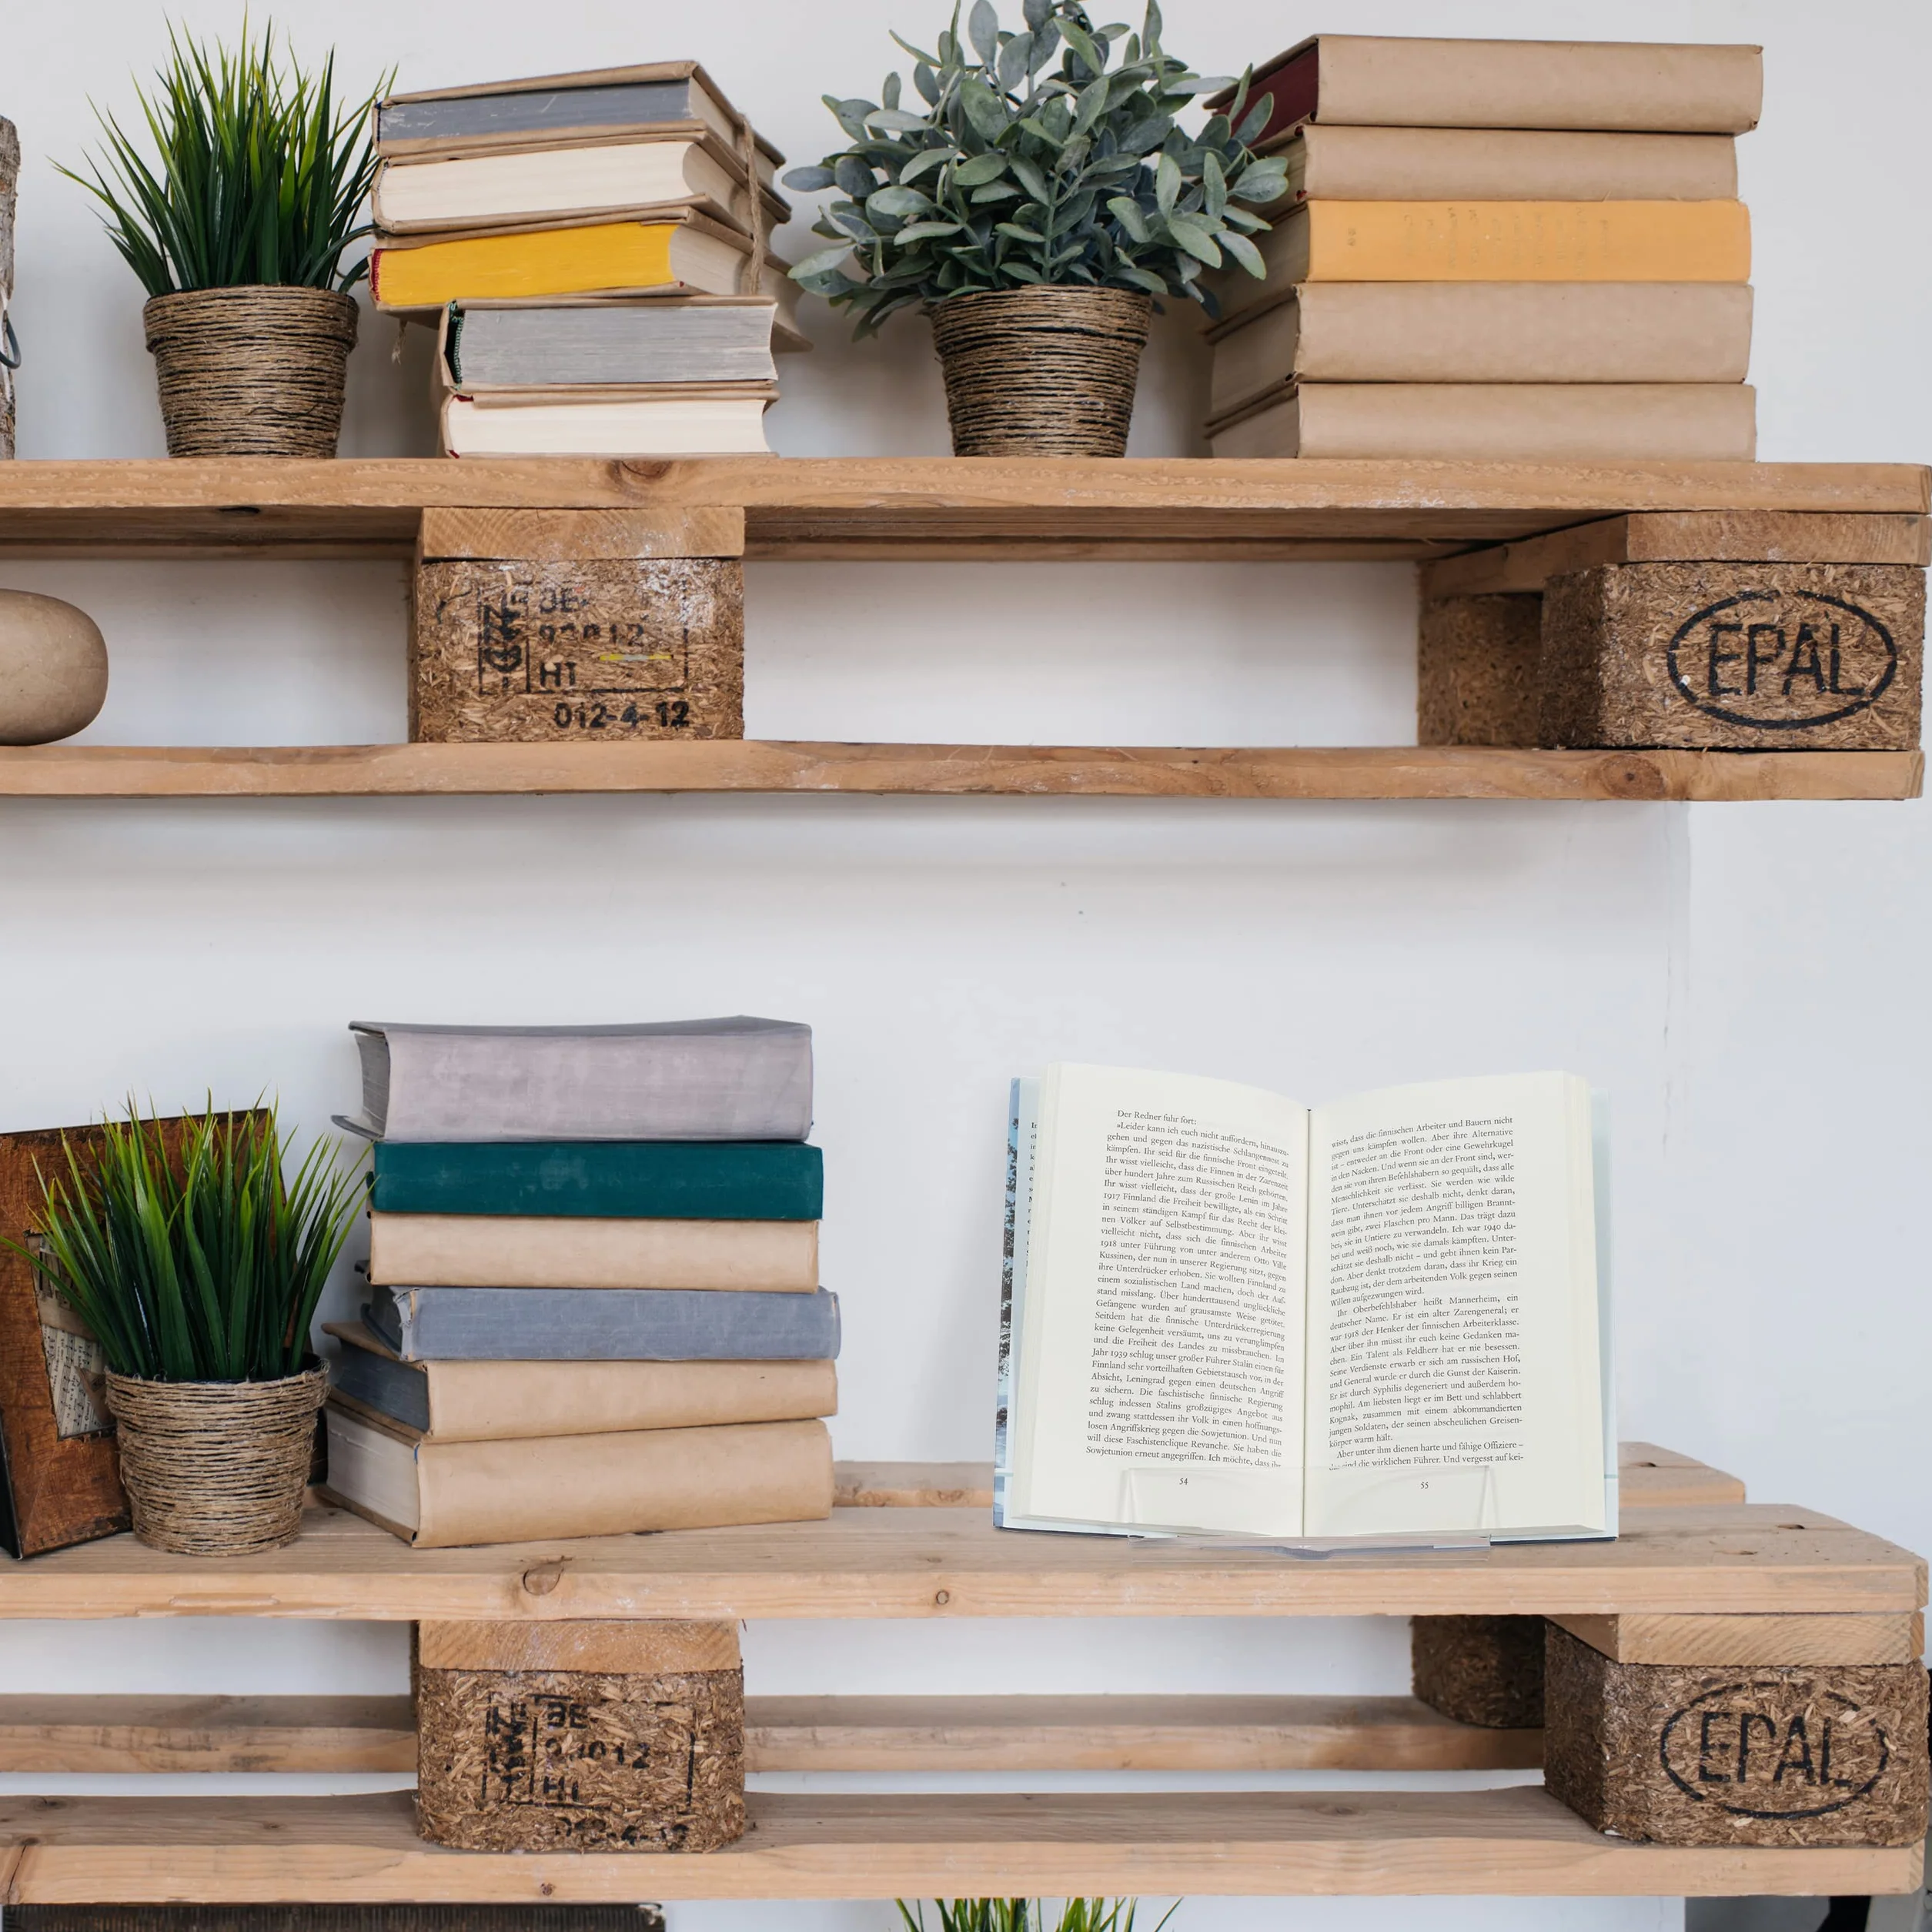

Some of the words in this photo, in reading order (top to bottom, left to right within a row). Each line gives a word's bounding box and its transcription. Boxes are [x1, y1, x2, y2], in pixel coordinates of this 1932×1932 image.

[540, 661, 577, 687] HT
[1707, 623, 1866, 696] EPAL
[553, 700, 690, 729] 012-4-12
[1117, 1108, 1132, 1118] Der
[1134, 1110, 1162, 1121] Redner
[1163, 1112, 1179, 1122] fuhr
[1180, 1115, 1197, 1125] fort:
[1331, 1138, 1349, 1148] wisst,
[1349, 1135, 1364, 1143] dass
[1365, 1131, 1376, 1139] die
[1378, 1125, 1414, 1137] finnischen
[1416, 1121, 1447, 1131] Arbeiter
[1448, 1118, 1463, 1128] und
[1493, 1115, 1513, 1125] nicht
[1331, 1149, 1349, 1162] gegen
[1367, 1138, 1397, 1150] kämpfen
[1400, 1135, 1427, 1145] wollen.
[1431, 1131, 1449, 1141] Aber
[1452, 1130, 1468, 1139] ihre
[1472, 1128, 1513, 1138] Alternative
[1107, 1131, 1130, 1141] gehen
[1132, 1134, 1148, 1142] und
[1150, 1137, 1173, 1146] gegen
[1175, 1137, 1188, 1147] das
[1192, 1141, 1231, 1153] nazistische
[1232, 1146, 1279, 1165] Schlangennest
[1105, 1166, 1122, 1175] über
[1124, 1168, 1154, 1178] hundert
[1155, 1171, 1175, 1181] Jahre
[1195, 1175, 1235, 1188] Russischen
[1237, 1182, 1257, 1193] Reich
[1258, 1188, 1288, 1201] gehörten.
[1331, 1184, 1342, 1193] den
[1343, 1181, 1352, 1189] sie
[1368, 1175, 1386, 1185] ihren
[1388, 1168, 1439, 1181] Befehlshabern
[1451, 1164, 1482, 1176] gequält,
[1482, 1163, 1499, 1172] dass
[1500, 1162, 1514, 1171] alle
[1103, 1192, 1121, 1202] 1917
[1122, 1192, 1156, 1202] Finnland
[1158, 1195, 1171, 1204] die
[1172, 1196, 1202, 1207] Freiheit
[1204, 1199, 1242, 1215] bewilligte,
[1243, 1206, 1253, 1215] als
[1255, 1209, 1265, 1218] ein
[1267, 1212, 1288, 1224] Schritt
[1331, 1206, 1350, 1215] Tiere.
[1352, 1196, 1396, 1210] Unterschätzt
[1398, 1194, 1409, 1202] sie
[1411, 1190, 1439, 1201] deshalb
[1442, 1188, 1464, 1198] nicht,
[1466, 1187, 1488, 1196] denkt
[1490, 1186, 1516, 1195] daran,
[1330, 1228, 1345, 1238] wein
[1347, 1224, 1363, 1236] gibt,
[1365, 1220, 1381, 1231] zwei
[1383, 1217, 1415, 1228] Flaschen
[1417, 1217, 1431, 1226] pro
[1432, 1214, 1457, 1222] Mann.
[1476, 1211, 1495, 1221] trägt
[1497, 1209, 1516, 1218] dazu
[1099, 1250, 1136, 1262] Kussinen,
[1137, 1252, 1152, 1262] der
[1169, 1255, 1177, 1264] in
[1179, 1258, 1208, 1267] unserer
[1209, 1259, 1248, 1275] Regierung
[1248, 1266, 1266, 1278] sitzt,
[1267, 1272, 1286, 1282] gegen
[1329, 1275, 1345, 1284] don.
[1346, 1270, 1364, 1280] Aber
[1365, 1266, 1385, 1277] denkt
[1388, 1263, 1422, 1274] trotzdem
[1423, 1262, 1448, 1270] daran,
[1449, 1259, 1466, 1269] dass
[1468, 1258, 1479, 1267] ihr
[1482, 1258, 1503, 1268] Krieg
[1505, 1257, 1517, 1265] ein
[1096, 1286, 1118, 1295] stand
[1121, 1289, 1156, 1300] misslang.
[1160, 1289, 1179, 1300] Über
[1182, 1292, 1240, 1306] hunderttausend
[1243, 1302, 1285, 1315] unglückliche
[1330, 1296, 1351, 1306] Willen
[1352, 1290, 1403, 1302] aufgezwungen
[1405, 1285, 1425, 1295] wird.
[1337, 1308, 1348, 1317] Ihr
[1352, 1299, 1417, 1314] Oberbefehlshaber
[1423, 1296, 1442, 1305] heißt
[1449, 1294, 1500, 1304] Mannerheim,
[1506, 1293, 1519, 1302] ein
[1094, 1322, 1115, 1332] keine
[1118, 1324, 1164, 1335] Gelegenheit
[1167, 1329, 1205, 1340] versäumt,
[1235, 1336, 1285, 1351] verunglimpfen
[1329, 1343, 1346, 1353] Aber
[1348, 1340, 1365, 1349] über
[1366, 1338, 1379, 1347] ihn
[1381, 1336, 1402, 1345] müsst
[1405, 1334, 1416, 1343] ihr
[1419, 1332, 1436, 1342] euch
[1439, 1332, 1460, 1341] keine
[1462, 1330, 1502, 1339] Gedanken
[1091, 1359, 1126, 1369] Finnland
[1127, 1362, 1145, 1370] sehr
[1145, 1363, 1194, 1373] vorteilhaften
[1195, 1366, 1248, 1379] Gebietstausch
[1249, 1374, 1263, 1384] vor,
[1264, 1375, 1272, 1383] in
[1272, 1376, 1284, 1386] der
[1329, 1367, 1347, 1376] Seine
[1349, 1362, 1387, 1372] Verdienste
[1389, 1358, 1416, 1368] erwarb
[1429, 1356, 1444, 1365] sich
[1461, 1354, 1500, 1364] russischen
[1502, 1353, 1521, 1363] Hof,
[1088, 1396, 1115, 1408] schlug
[1118, 1398, 1152, 1408] indessen
[1155, 1400, 1182, 1409] Stalins
[1185, 1402, 1232, 1415] großzügiges
[1236, 1407, 1268, 1419] Angebot
[1088, 1420, 1108, 1429] losen
[1110, 1422, 1160, 1436] Angriffskrieg
[1162, 1427, 1185, 1436] gegen
[1187, 1426, 1199, 1435] die
[1201, 1428, 1249, 1440] Sowjetunion.
[1252, 1433, 1267, 1442] Und
[1178, 1477, 1188, 1486] 54
[1420, 1481, 1429, 1489] 55
[1698, 1710, 1857, 1787] EPAL
